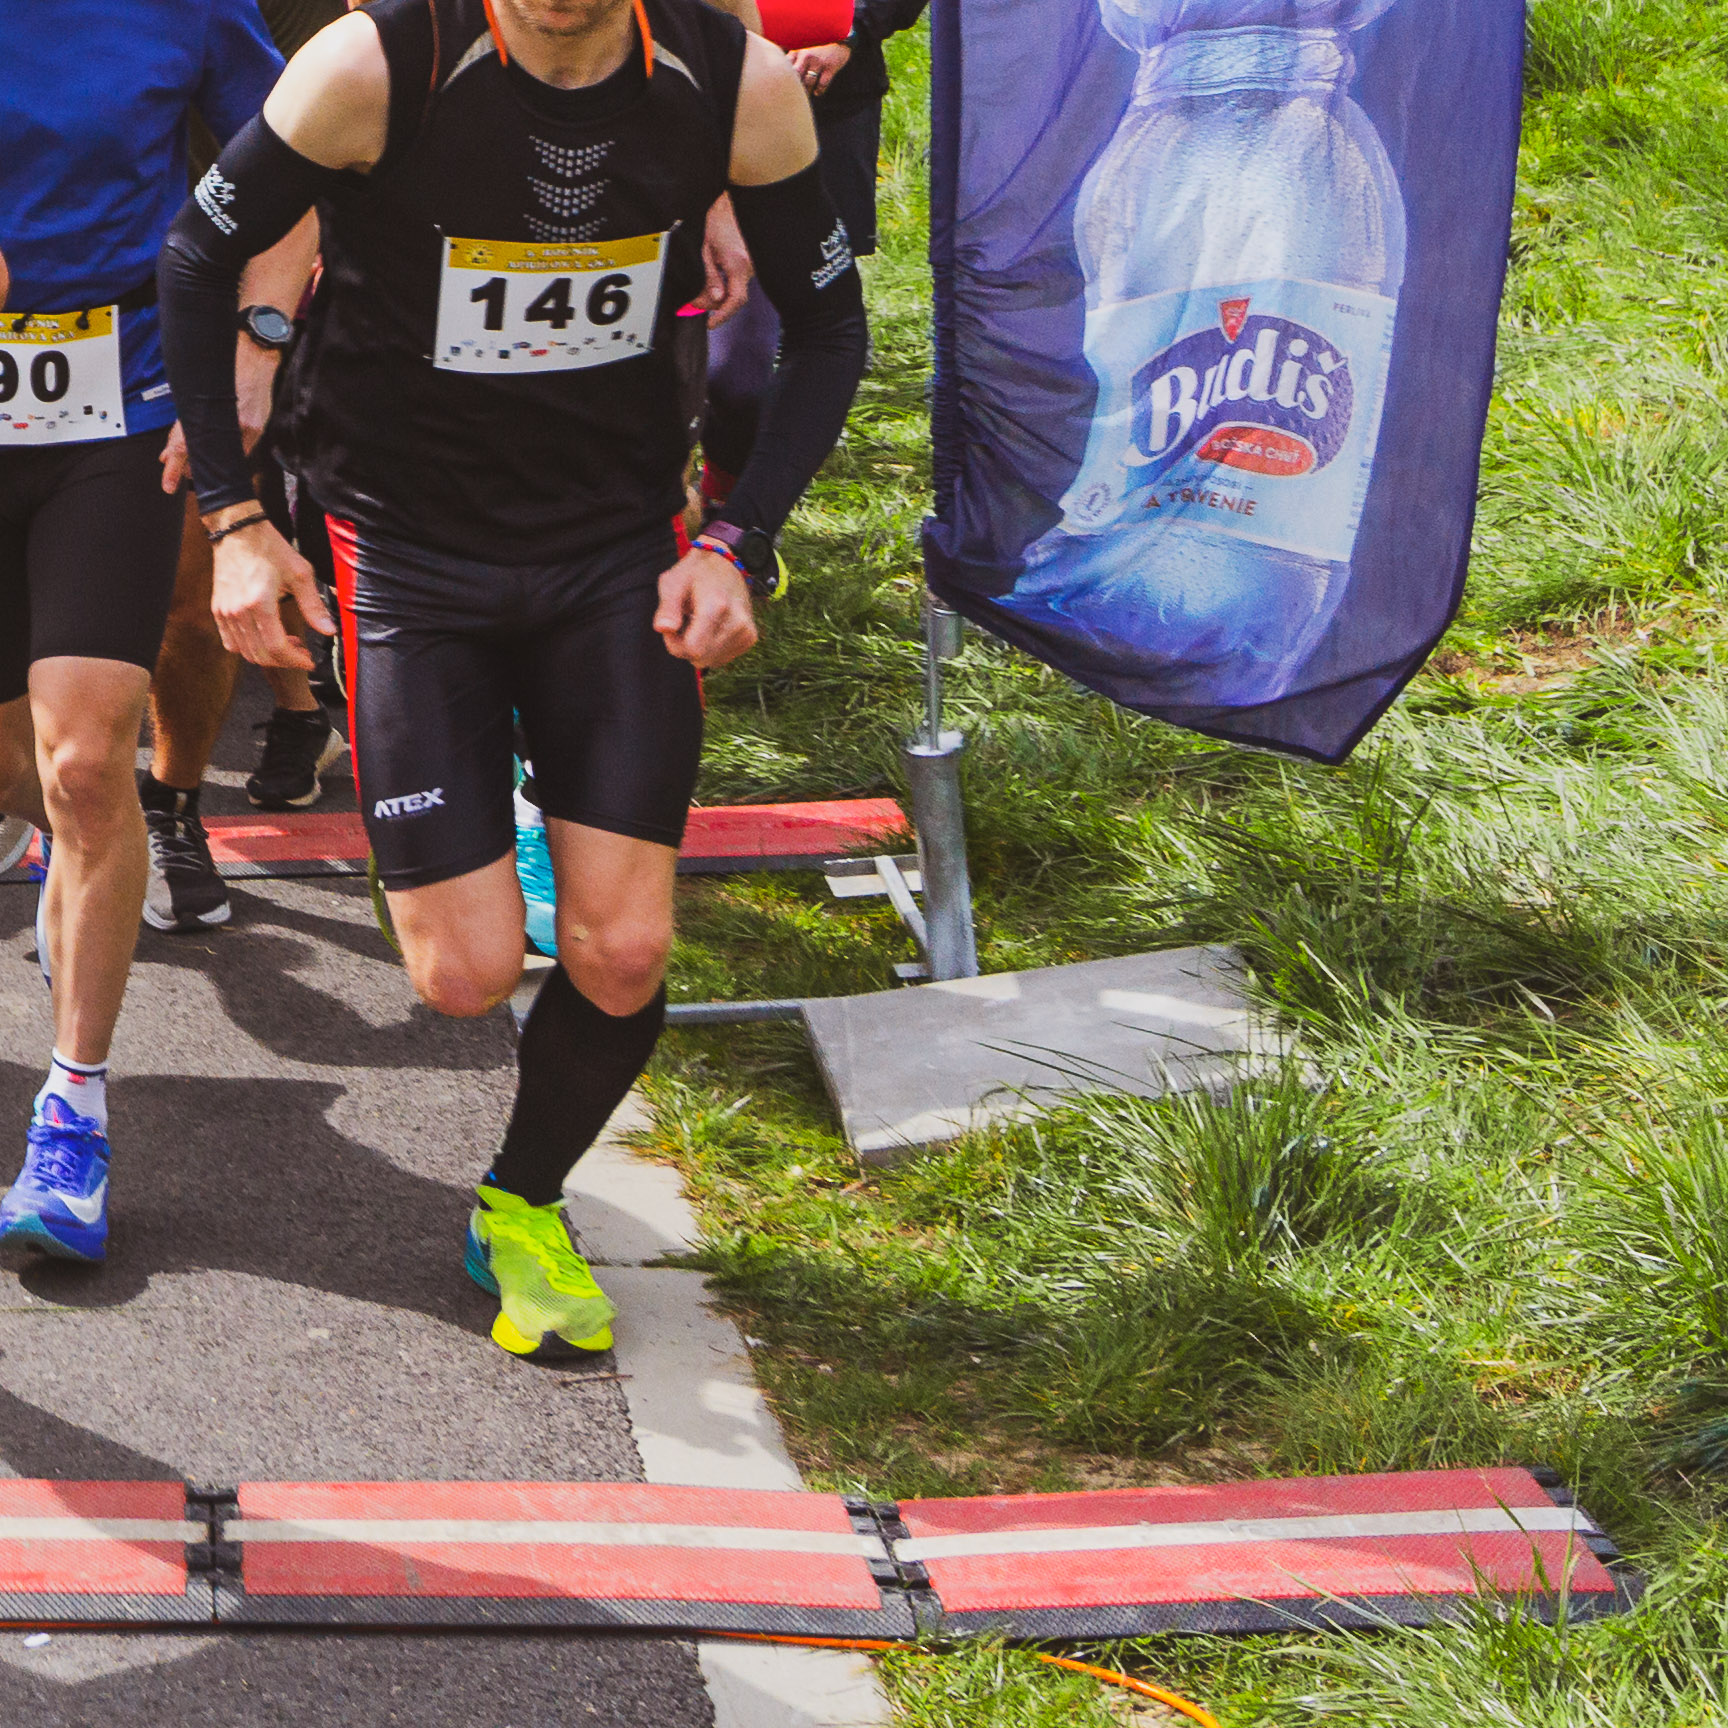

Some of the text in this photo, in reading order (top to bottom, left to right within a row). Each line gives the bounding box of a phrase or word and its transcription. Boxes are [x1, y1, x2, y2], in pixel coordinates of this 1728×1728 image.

[470, 273, 633, 331] 146
[1122, 328, 1349, 467] Budiš
[374, 787, 446, 819] ATEX
